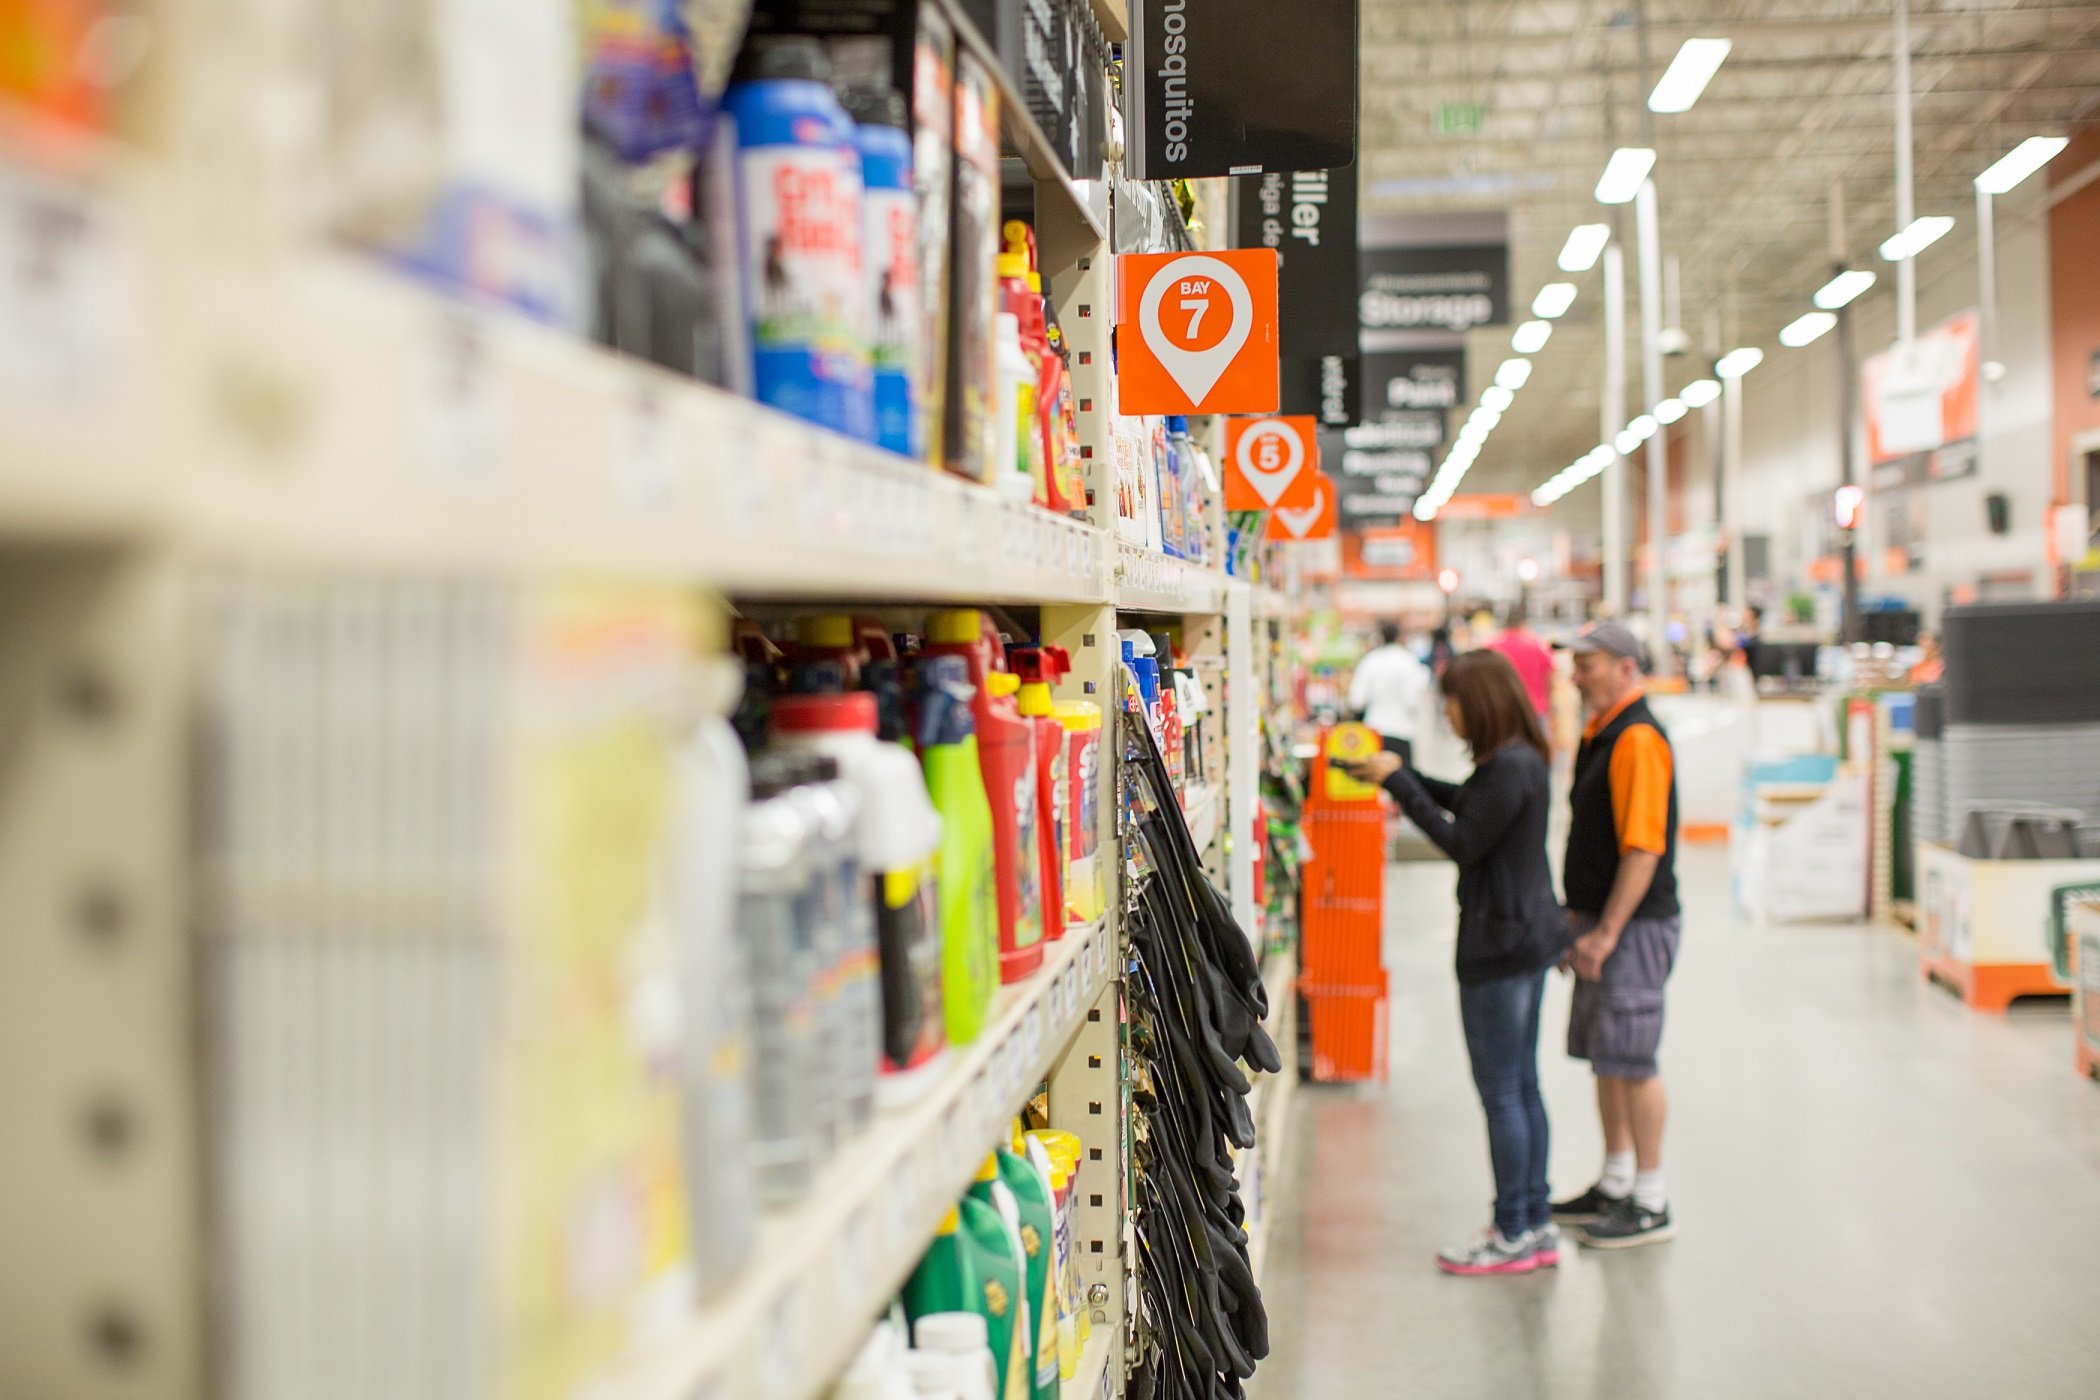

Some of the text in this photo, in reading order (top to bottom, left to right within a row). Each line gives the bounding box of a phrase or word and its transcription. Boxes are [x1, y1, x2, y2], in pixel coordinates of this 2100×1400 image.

[1291, 169, 1328, 246] iller
[1180, 281, 1211, 295] BAY
[1180, 299, 1210, 340] 7
[1359, 290, 1493, 331] Storage
[1259, 445, 1281, 470] 5
